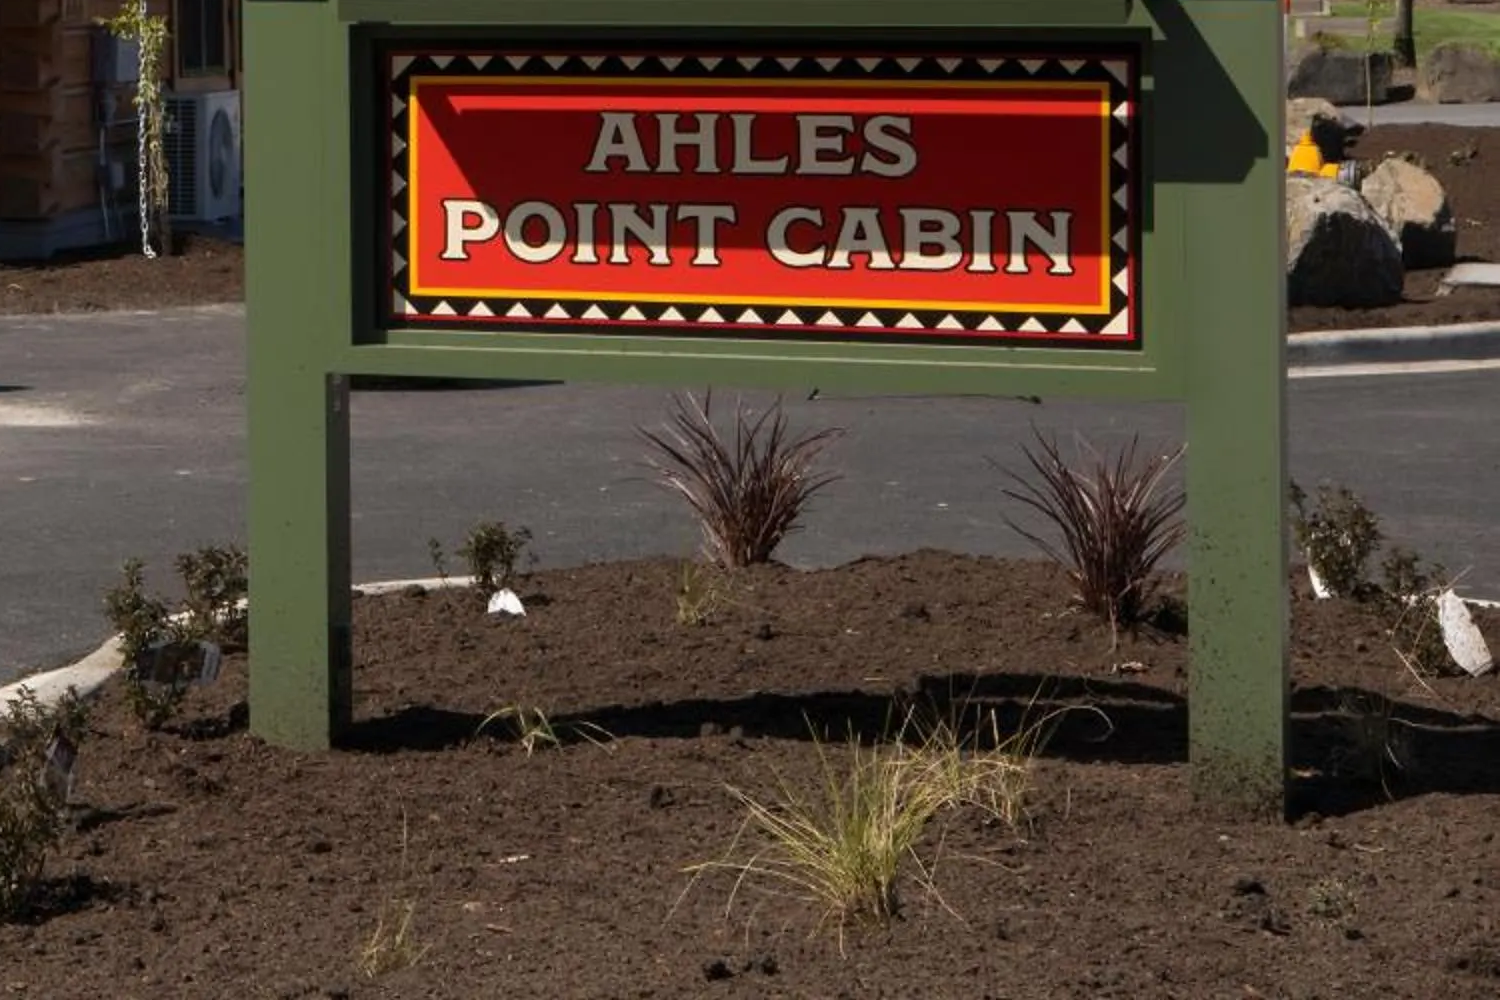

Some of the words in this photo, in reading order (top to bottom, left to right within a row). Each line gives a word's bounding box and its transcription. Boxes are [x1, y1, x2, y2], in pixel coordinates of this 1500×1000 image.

[584, 111, 918, 178] AHLES
[440, 199, 737, 266] POINT
[765, 206, 1075, 274] CABIN
